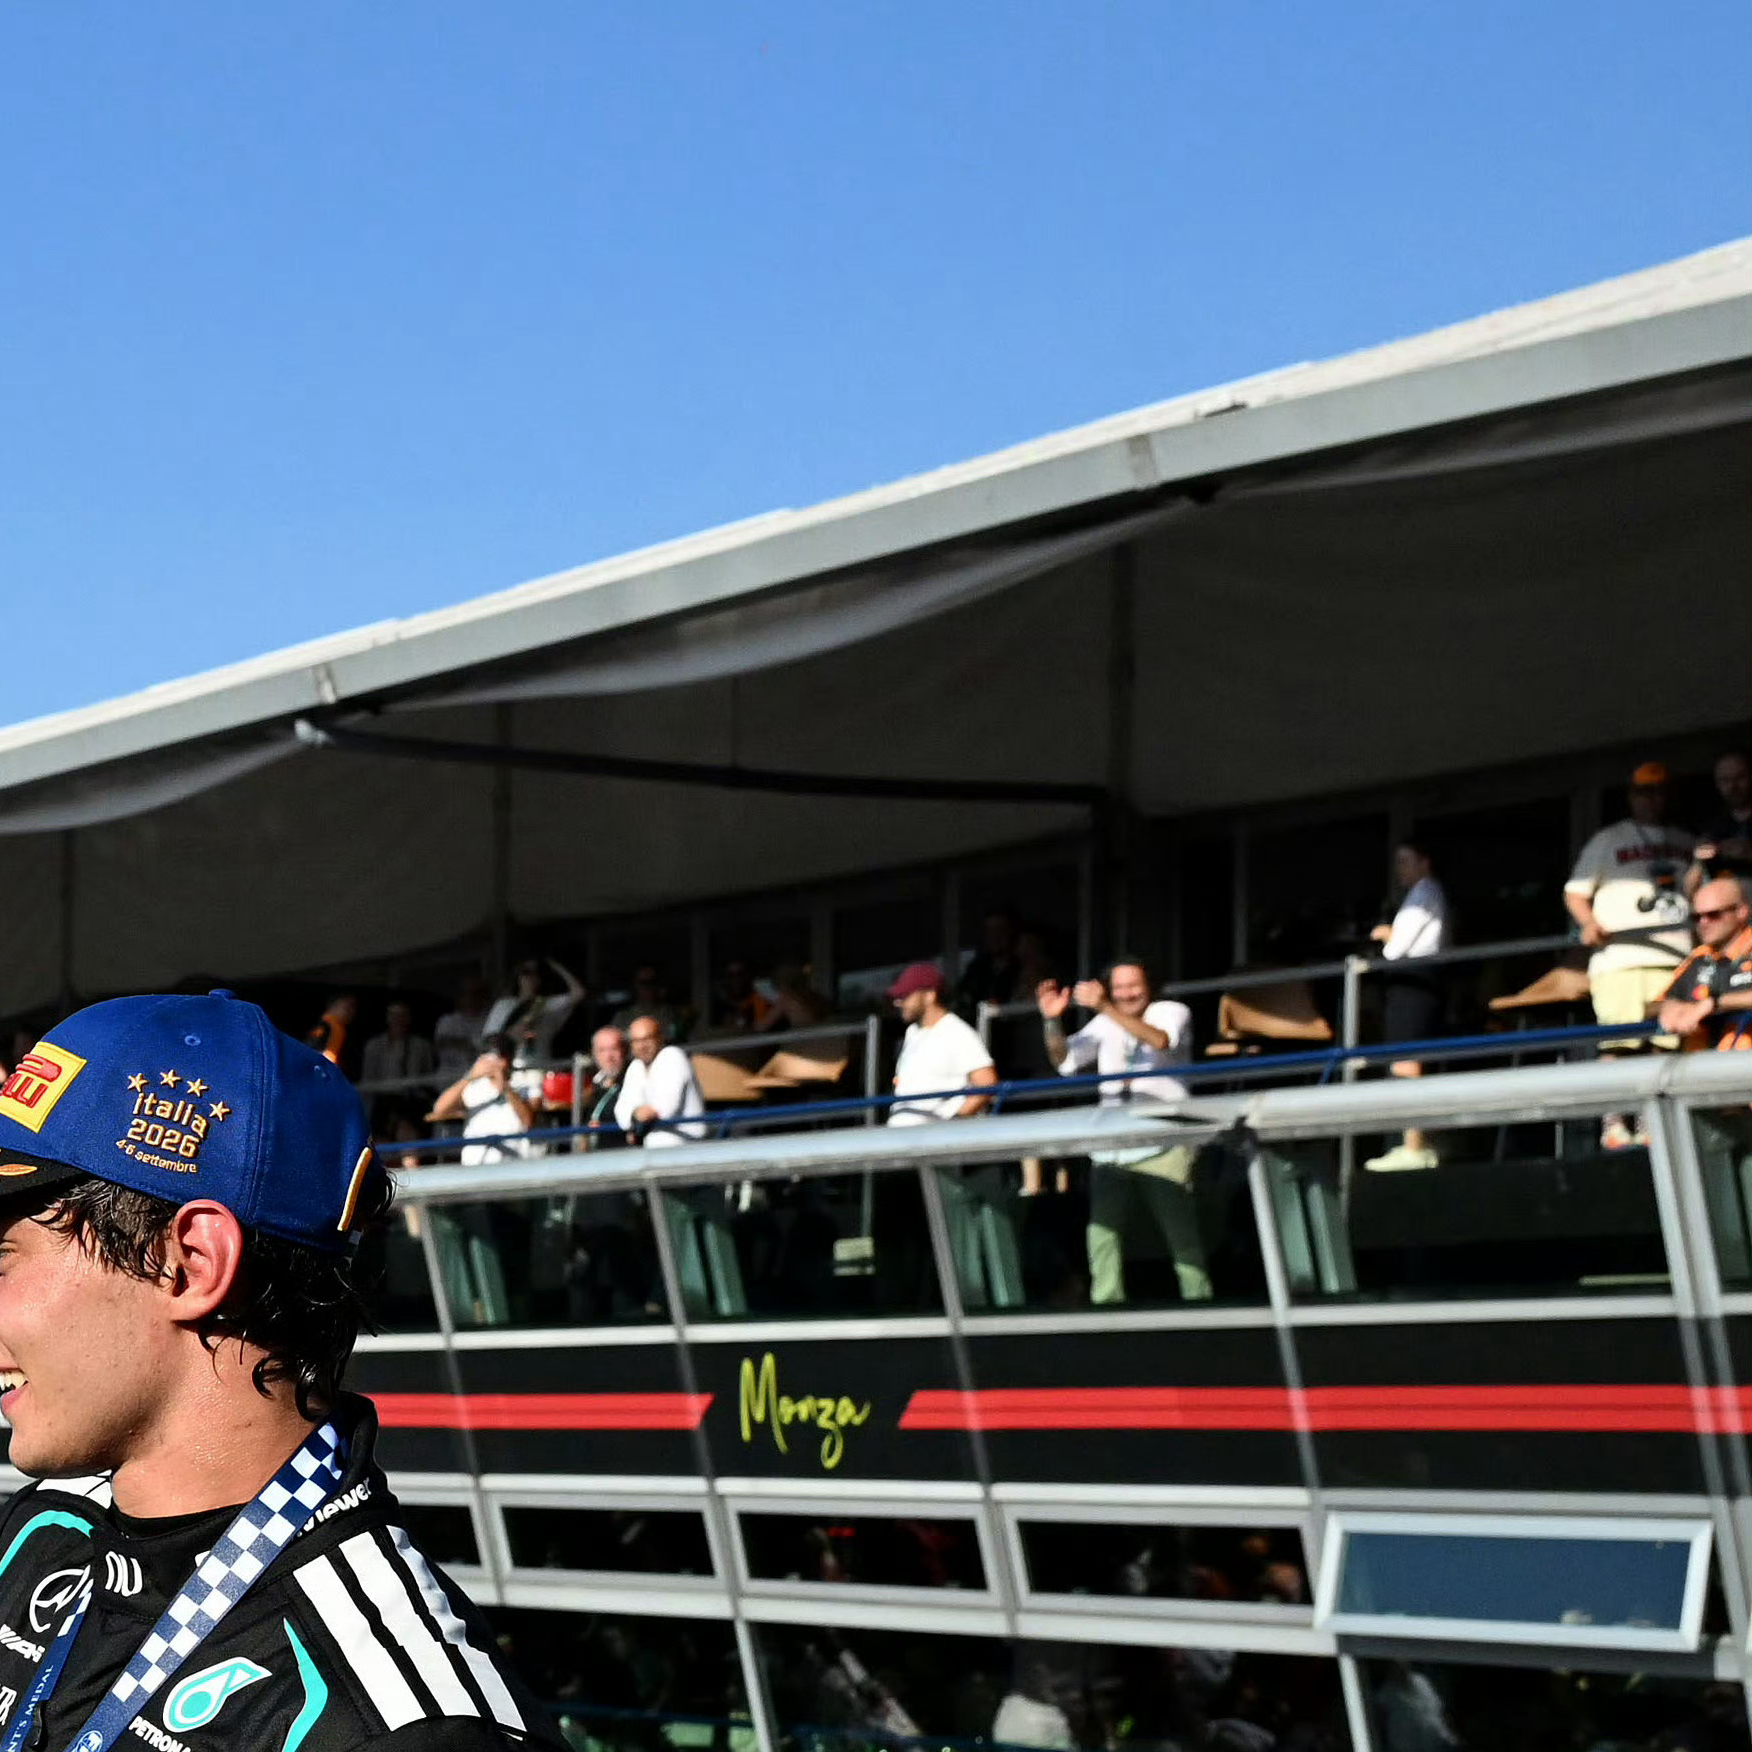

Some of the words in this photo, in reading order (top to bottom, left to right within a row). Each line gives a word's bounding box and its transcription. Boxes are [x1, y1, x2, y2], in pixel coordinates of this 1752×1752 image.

[127, 1118, 200, 1158] 2026
[132, 1091, 208, 1139] italia
[134, 1150, 198, 1174] settembre
[738, 1352, 870, 1470] Monza
[24, 1664, 55, 1717] MEDAL
